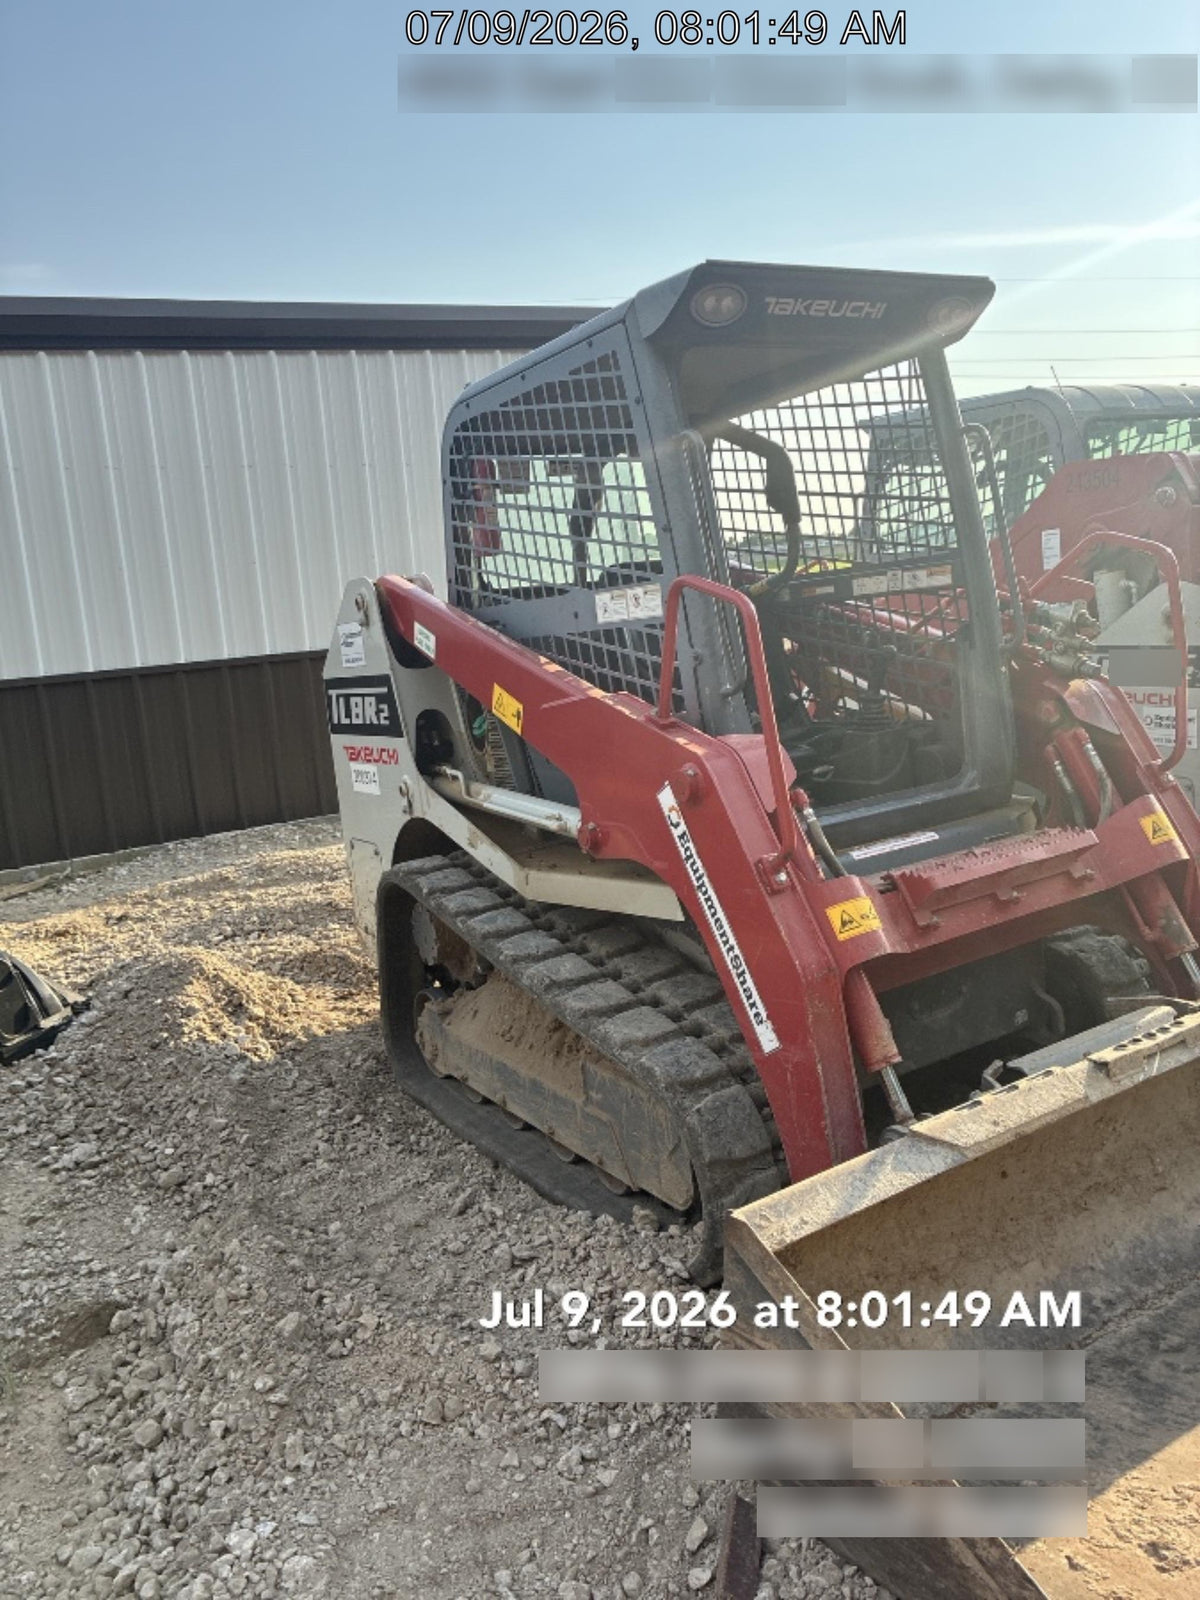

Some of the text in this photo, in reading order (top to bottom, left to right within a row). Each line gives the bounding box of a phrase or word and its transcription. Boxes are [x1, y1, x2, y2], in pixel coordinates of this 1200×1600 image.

[764, 297, 887, 319] TAKEUCHI
[328, 687, 390, 725] TL8R2
[343, 746, 399, 765] TAKEUCHI
[677, 830, 765, 1027] EquipmentShare
